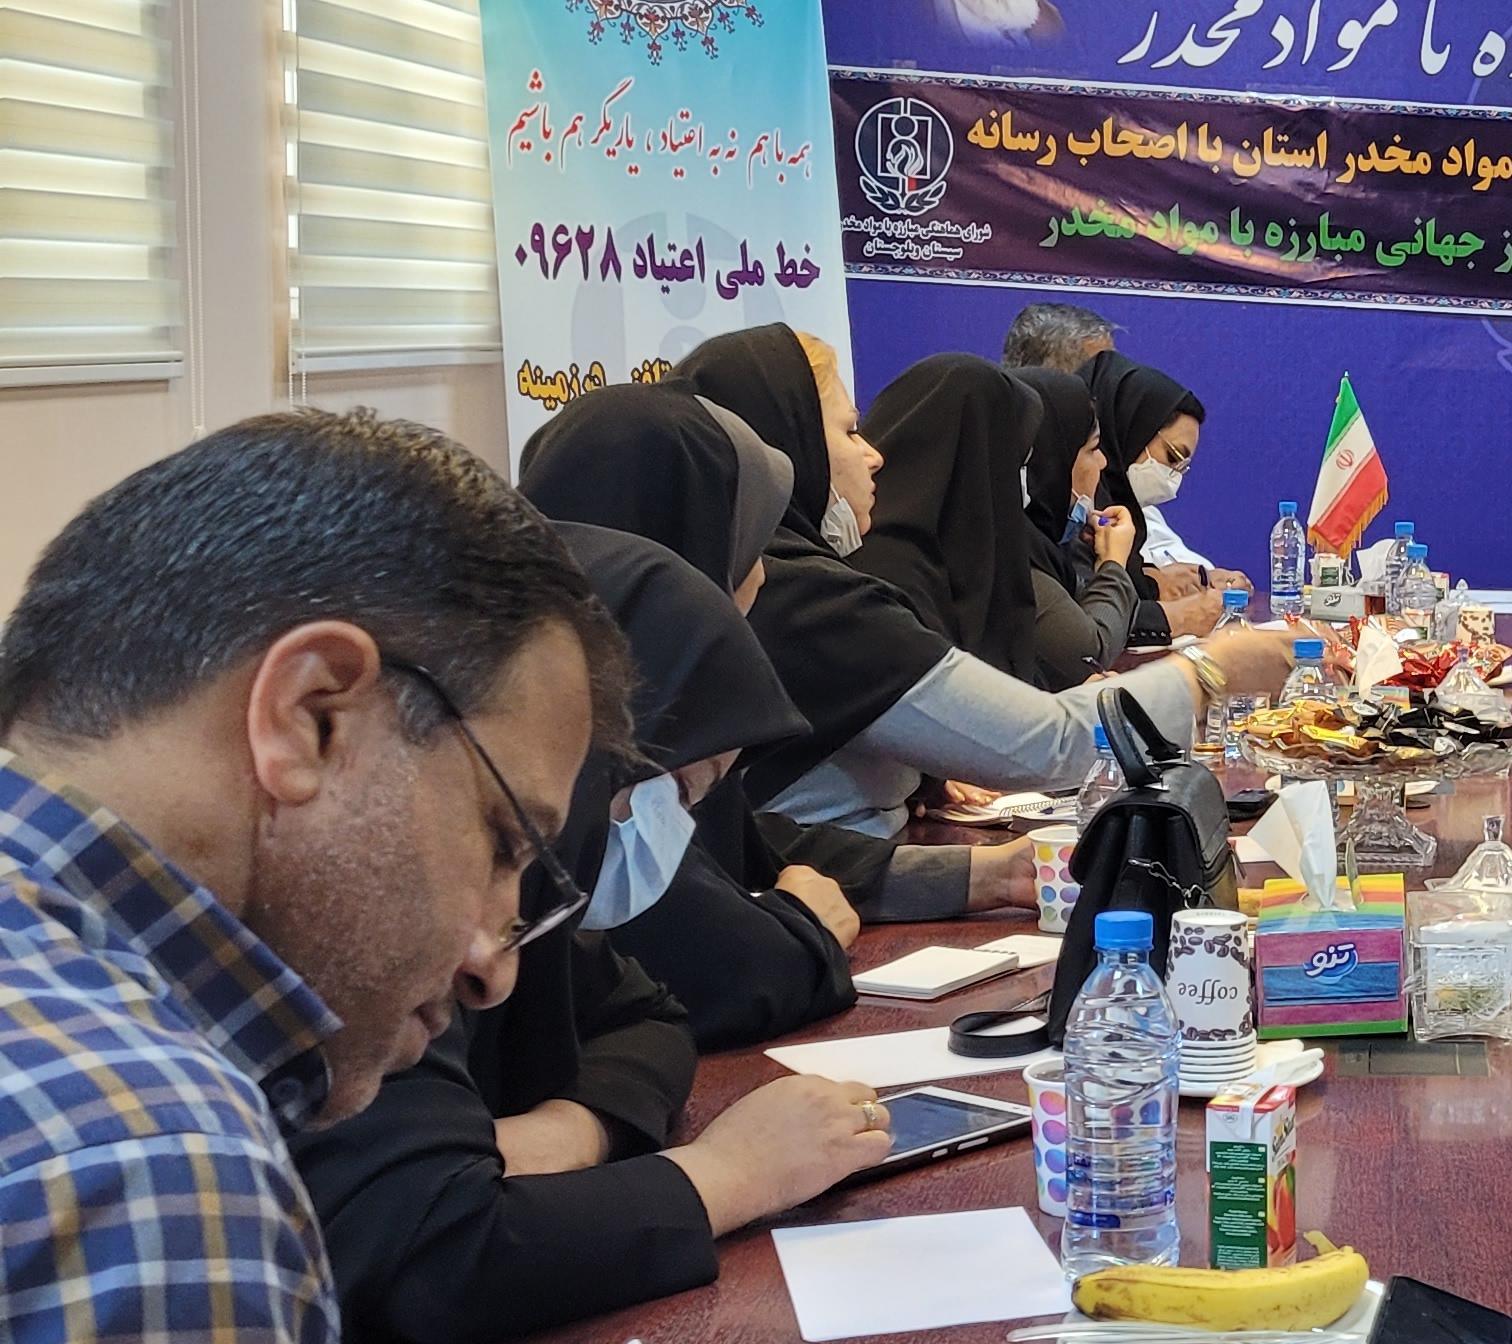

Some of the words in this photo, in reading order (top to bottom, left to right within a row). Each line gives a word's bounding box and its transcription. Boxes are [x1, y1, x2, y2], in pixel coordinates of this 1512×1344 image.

[507, 69, 553, 167] باشیم
[559, 113, 584, 169] هم
[966, 108, 1057, 168] رسانه
[746, 132, 769, 189] هم
[787, 143, 811, 178] همه
[1066, 120, 1188, 168] اصحاب
[1197, 125, 1225, 175] با
[1231, 128, 1330, 177] استان
[1336, 132, 1433, 185] مخدر
[840, 215, 863, 232] مخد
[920, 220, 963, 240] هماهنگی
[961, 222, 993, 244] شورای
[1038, 199, 1137, 248] مخدر
[1146, 202, 1221, 257] مواد
[1228, 206, 1255, 260] با
[1262, 212, 1366, 265] مبارزه
[1374, 216, 1486, 270] جهانی
[632, 232, 706, 295] اعتیاد
[715, 238, 766, 300] ملی
[773, 241, 822, 290] خط
[922, 240, 964, 262] سیستان
[1305, 942, 1356, 978] تنو
[1178, 978, 1238, 1005] coffee
